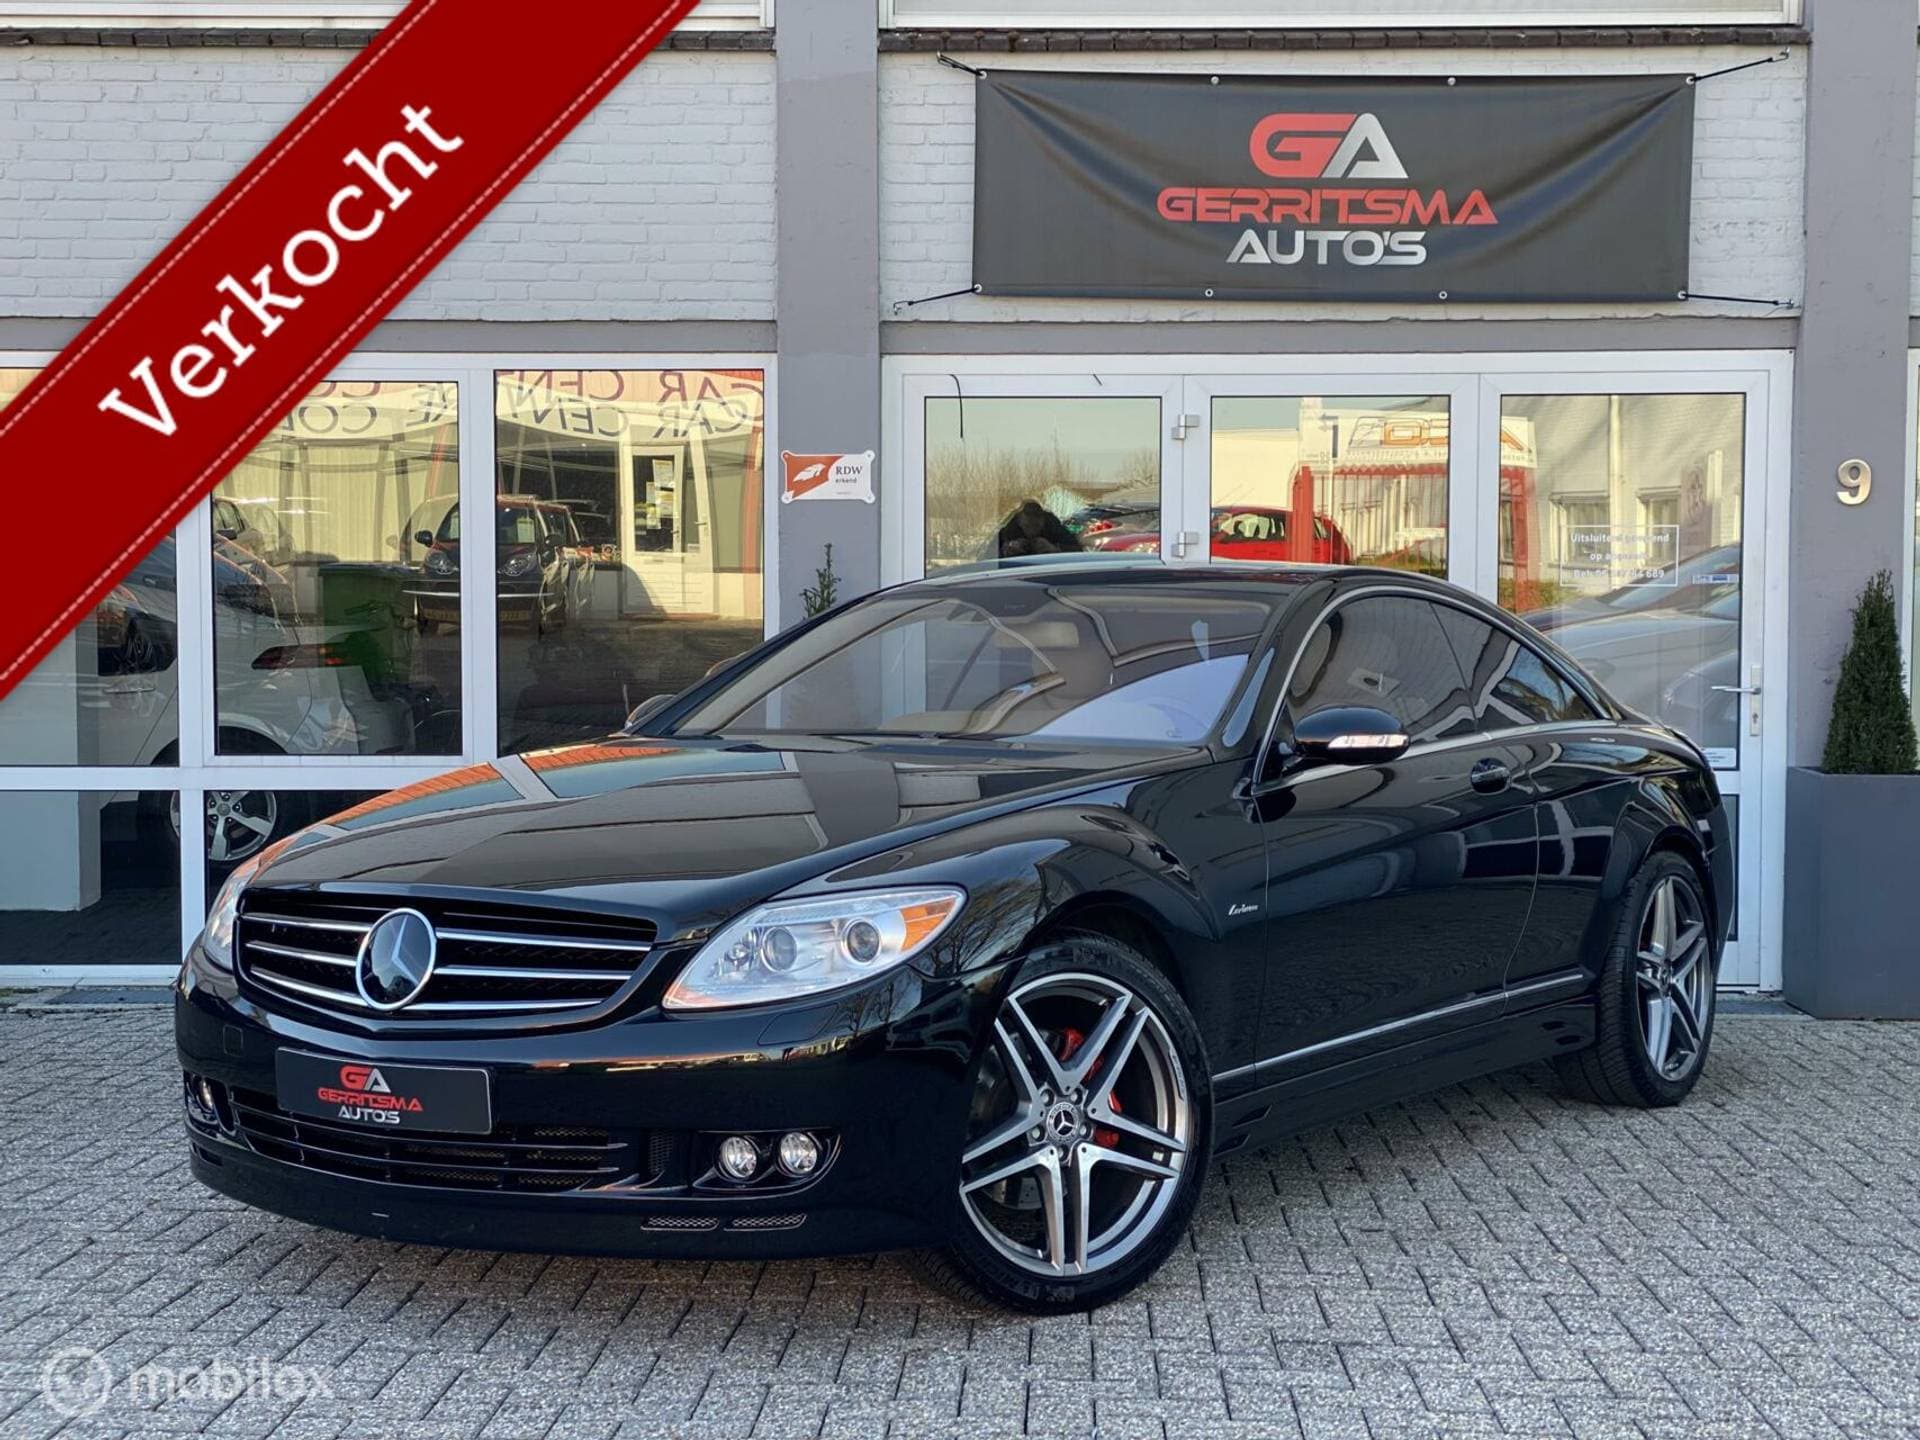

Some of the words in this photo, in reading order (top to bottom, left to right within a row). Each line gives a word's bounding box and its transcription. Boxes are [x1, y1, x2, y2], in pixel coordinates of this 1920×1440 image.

[1249, 113, 1408, 179] GA
[1156, 187, 1499, 225] GERRITSMA
[1226, 229, 1428, 266] AUTO'S
[835, 465, 863, 475] RDW
[1837, 459, 1871, 505] 9
[340, 1065, 391, 1093] GA
[317, 1086, 424, 1112] GERRITSMA
[338, 1105, 401, 1125] AUTO'S
